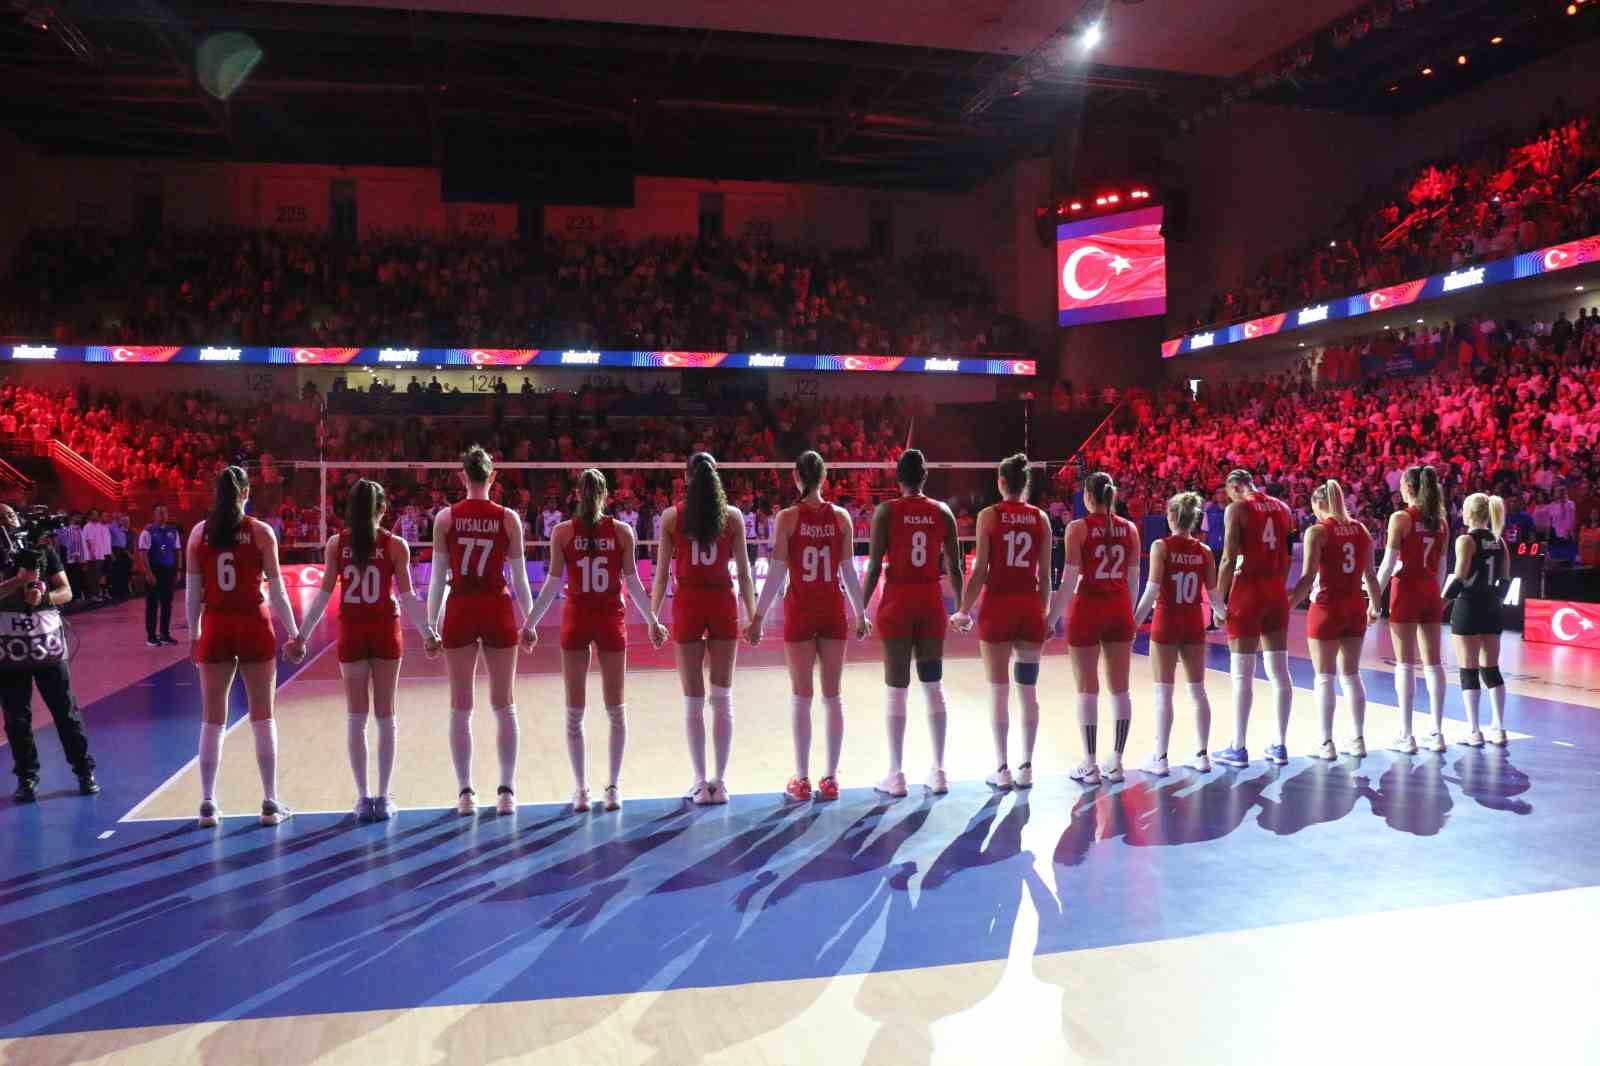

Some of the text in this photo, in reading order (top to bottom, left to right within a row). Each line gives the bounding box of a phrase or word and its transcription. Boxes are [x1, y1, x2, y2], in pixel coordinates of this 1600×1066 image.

[469, 210, 496, 226] 224
[470, 374, 498, 392] 124
[456, 518, 500, 533] UYSALCAN
[904, 515, 936, 525] KISAL
[1262, 517, 1277, 550] 4
[458, 538, 494, 576] 77
[803, 545, 832, 582] 91
[912, 530, 927, 567] 8
[1003, 530, 1032, 567] 12
[1095, 544, 1125, 579] 22
[1343, 542, 1356, 574] 3
[1422, 537, 1435, 568] 7
[217, 552, 236, 592] 6
[343, 565, 380, 604] 20
[576, 556, 609, 592] 16
[1486, 556, 1495, 585] 1
[1171, 571, 1198, 604] 10
